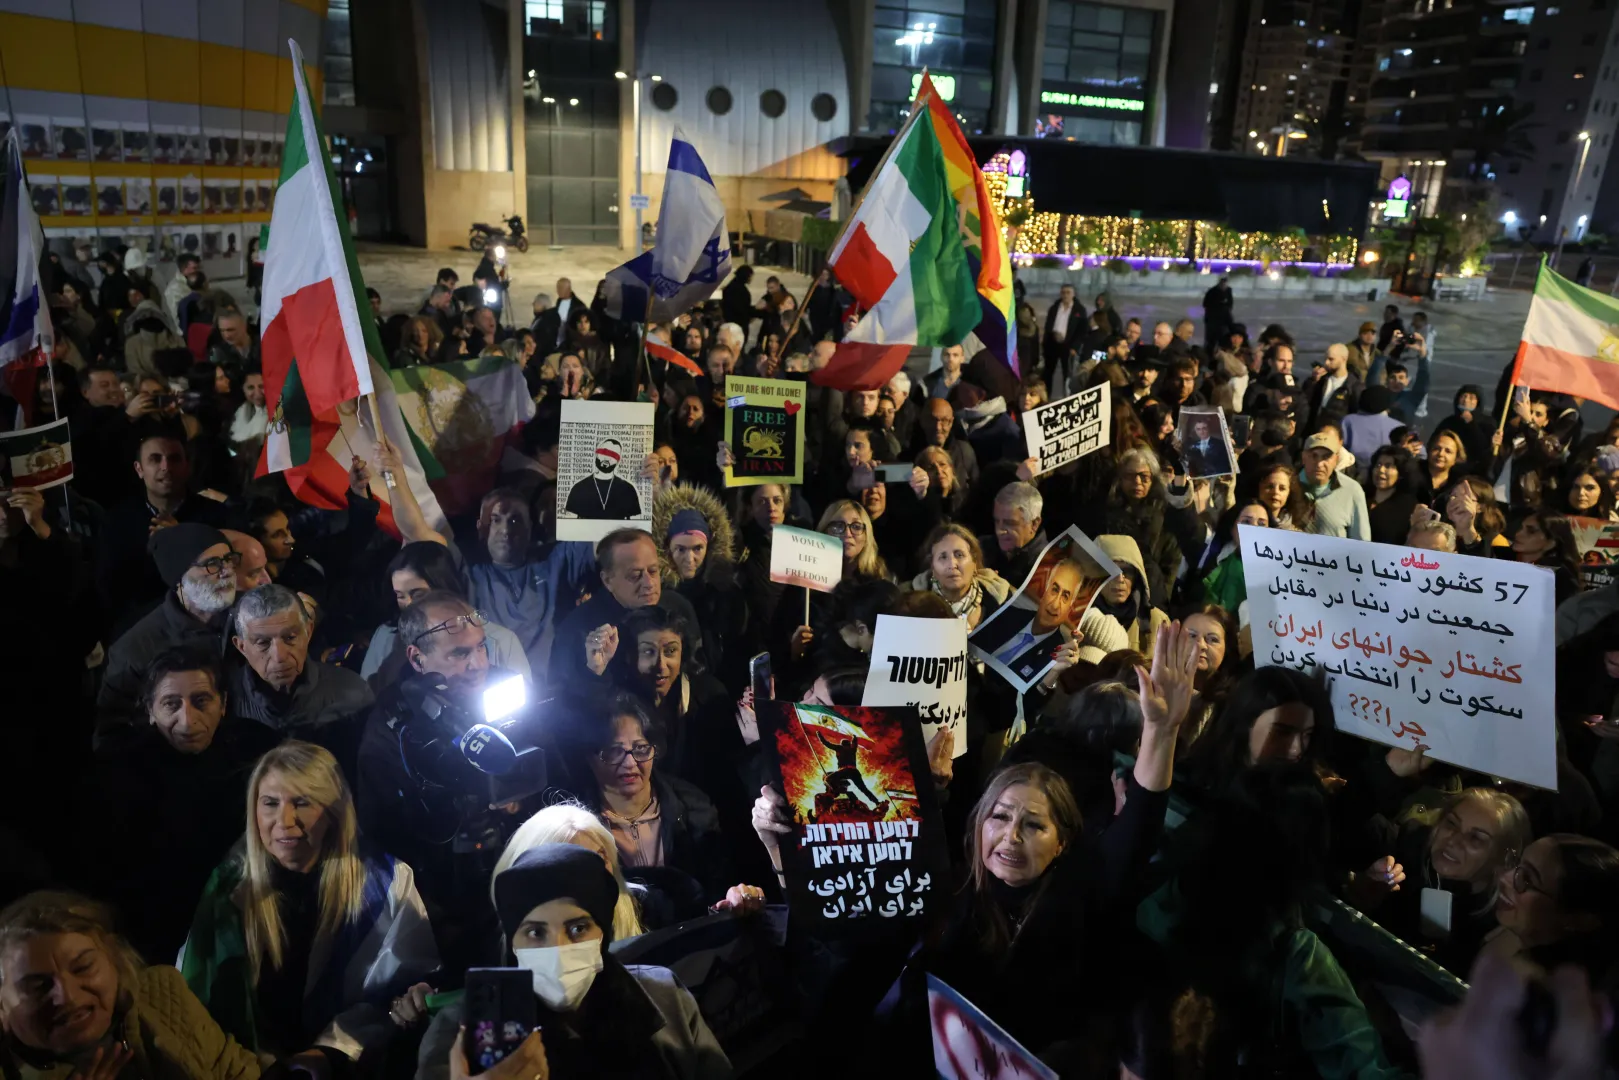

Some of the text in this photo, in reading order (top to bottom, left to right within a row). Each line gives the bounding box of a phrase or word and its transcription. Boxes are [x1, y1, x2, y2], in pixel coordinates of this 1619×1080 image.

[1070, 94, 1078, 105] &
[730, 383, 802, 398] YOU ARE NOT ALONE!
[743, 410, 786, 424] FREE
[1040, 391, 1099, 425] صدای مردم
[1044, 402, 1098, 437] ایران باشید
[1042, 443, 1057, 458] של
[743, 460, 785, 472] IRAN
[792, 535, 826, 549] WOMAN
[798, 553, 818, 565] LIFE
[1253, 541, 1530, 605] 57 کشور دنیا با میلیاردها
[785, 567, 828, 584] FREEDOM
[1269, 576, 1515, 645] جمعیت در دنیا در مقابل
[887, 650, 965, 689] לדיקטטור
[1440, 650, 1524, 684] کشتار
[1271, 644, 1523, 720] سکوت را انتخاب کردن
[470, 731, 491, 754] 15
[802, 818, 920, 847] למען החירות,
[812, 839, 913, 868] למען איראן
[808, 867, 931, 896] برای آزادی،
[822, 892, 924, 919] برای ایران
